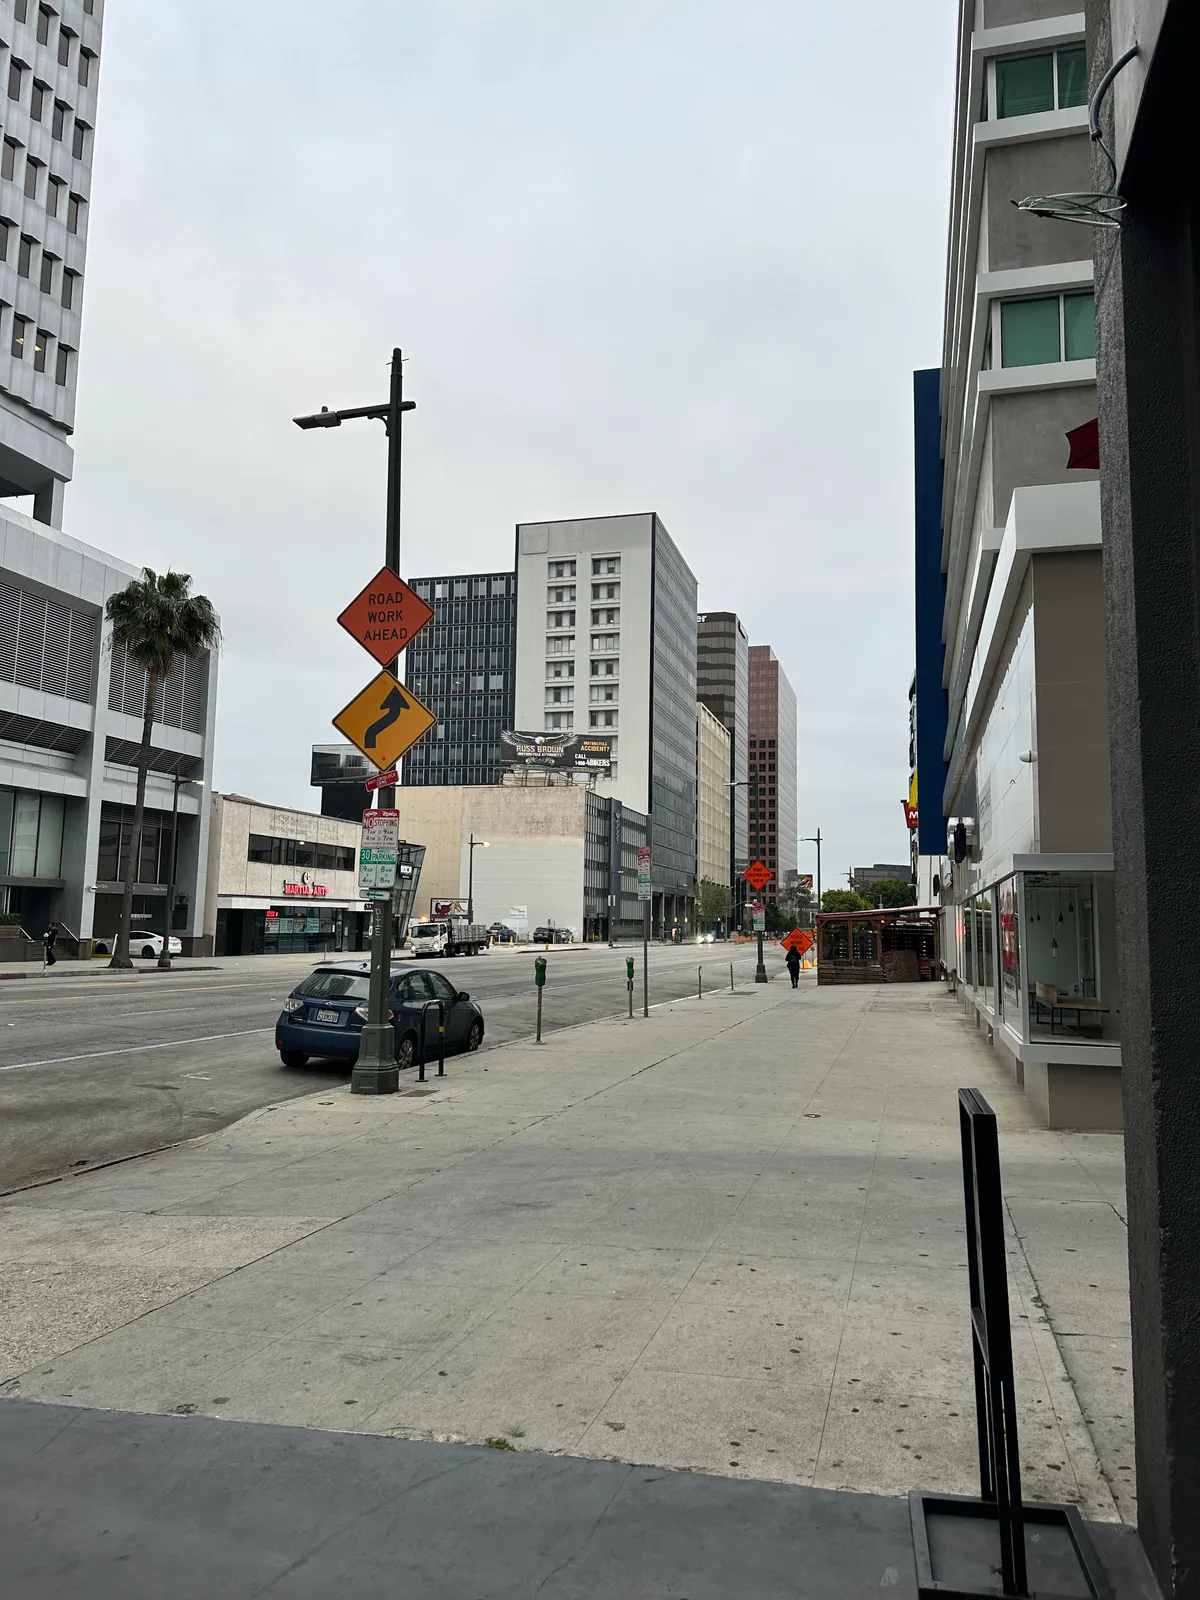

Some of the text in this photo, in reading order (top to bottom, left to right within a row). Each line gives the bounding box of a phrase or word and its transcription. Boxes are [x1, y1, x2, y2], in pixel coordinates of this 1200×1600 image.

[368, 592, 403, 605] ROAD
[367, 610, 403, 623] WORK
[363, 628, 408, 642] AHEAD
[537, 745, 564, 753] BROWN
[367, 773, 396, 785] ANTI-GRIDLOCK
[363, 817, 398, 828] NO STOPPING
[361, 849, 371, 860] 30
[371, 853, 395, 861] PARKING
[285, 884, 329, 896] MARTIAL ARTS
